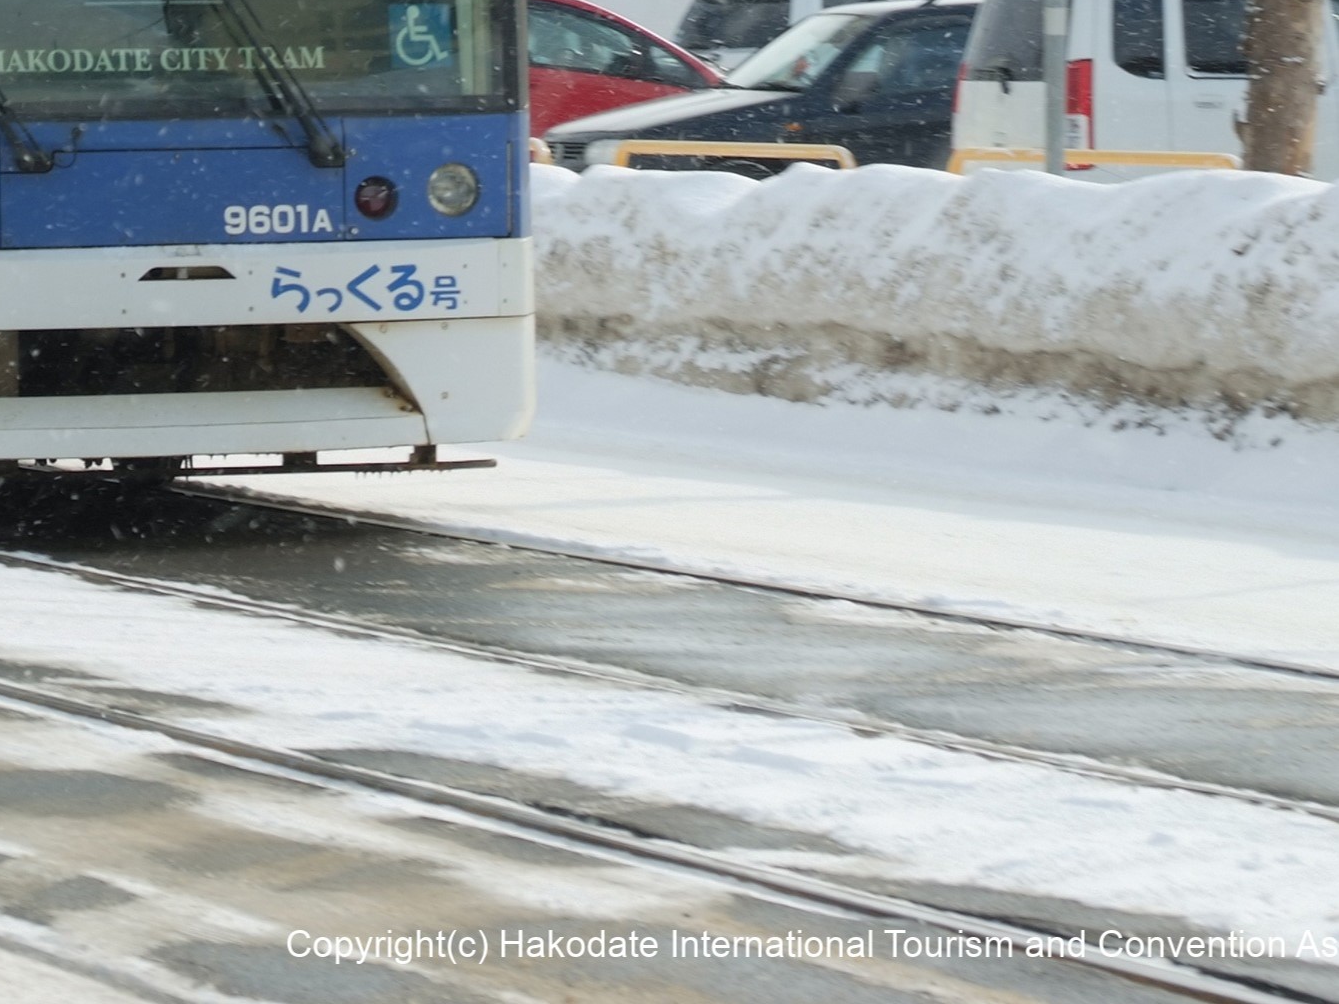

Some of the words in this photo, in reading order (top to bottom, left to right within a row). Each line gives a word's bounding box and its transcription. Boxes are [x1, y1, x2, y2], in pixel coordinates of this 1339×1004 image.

[160, 47, 231, 71] CITY
[238, 46, 326, 70] TRAM
[224, 204, 333, 235] 9601A
[271, 263, 461, 314] らっくる号
